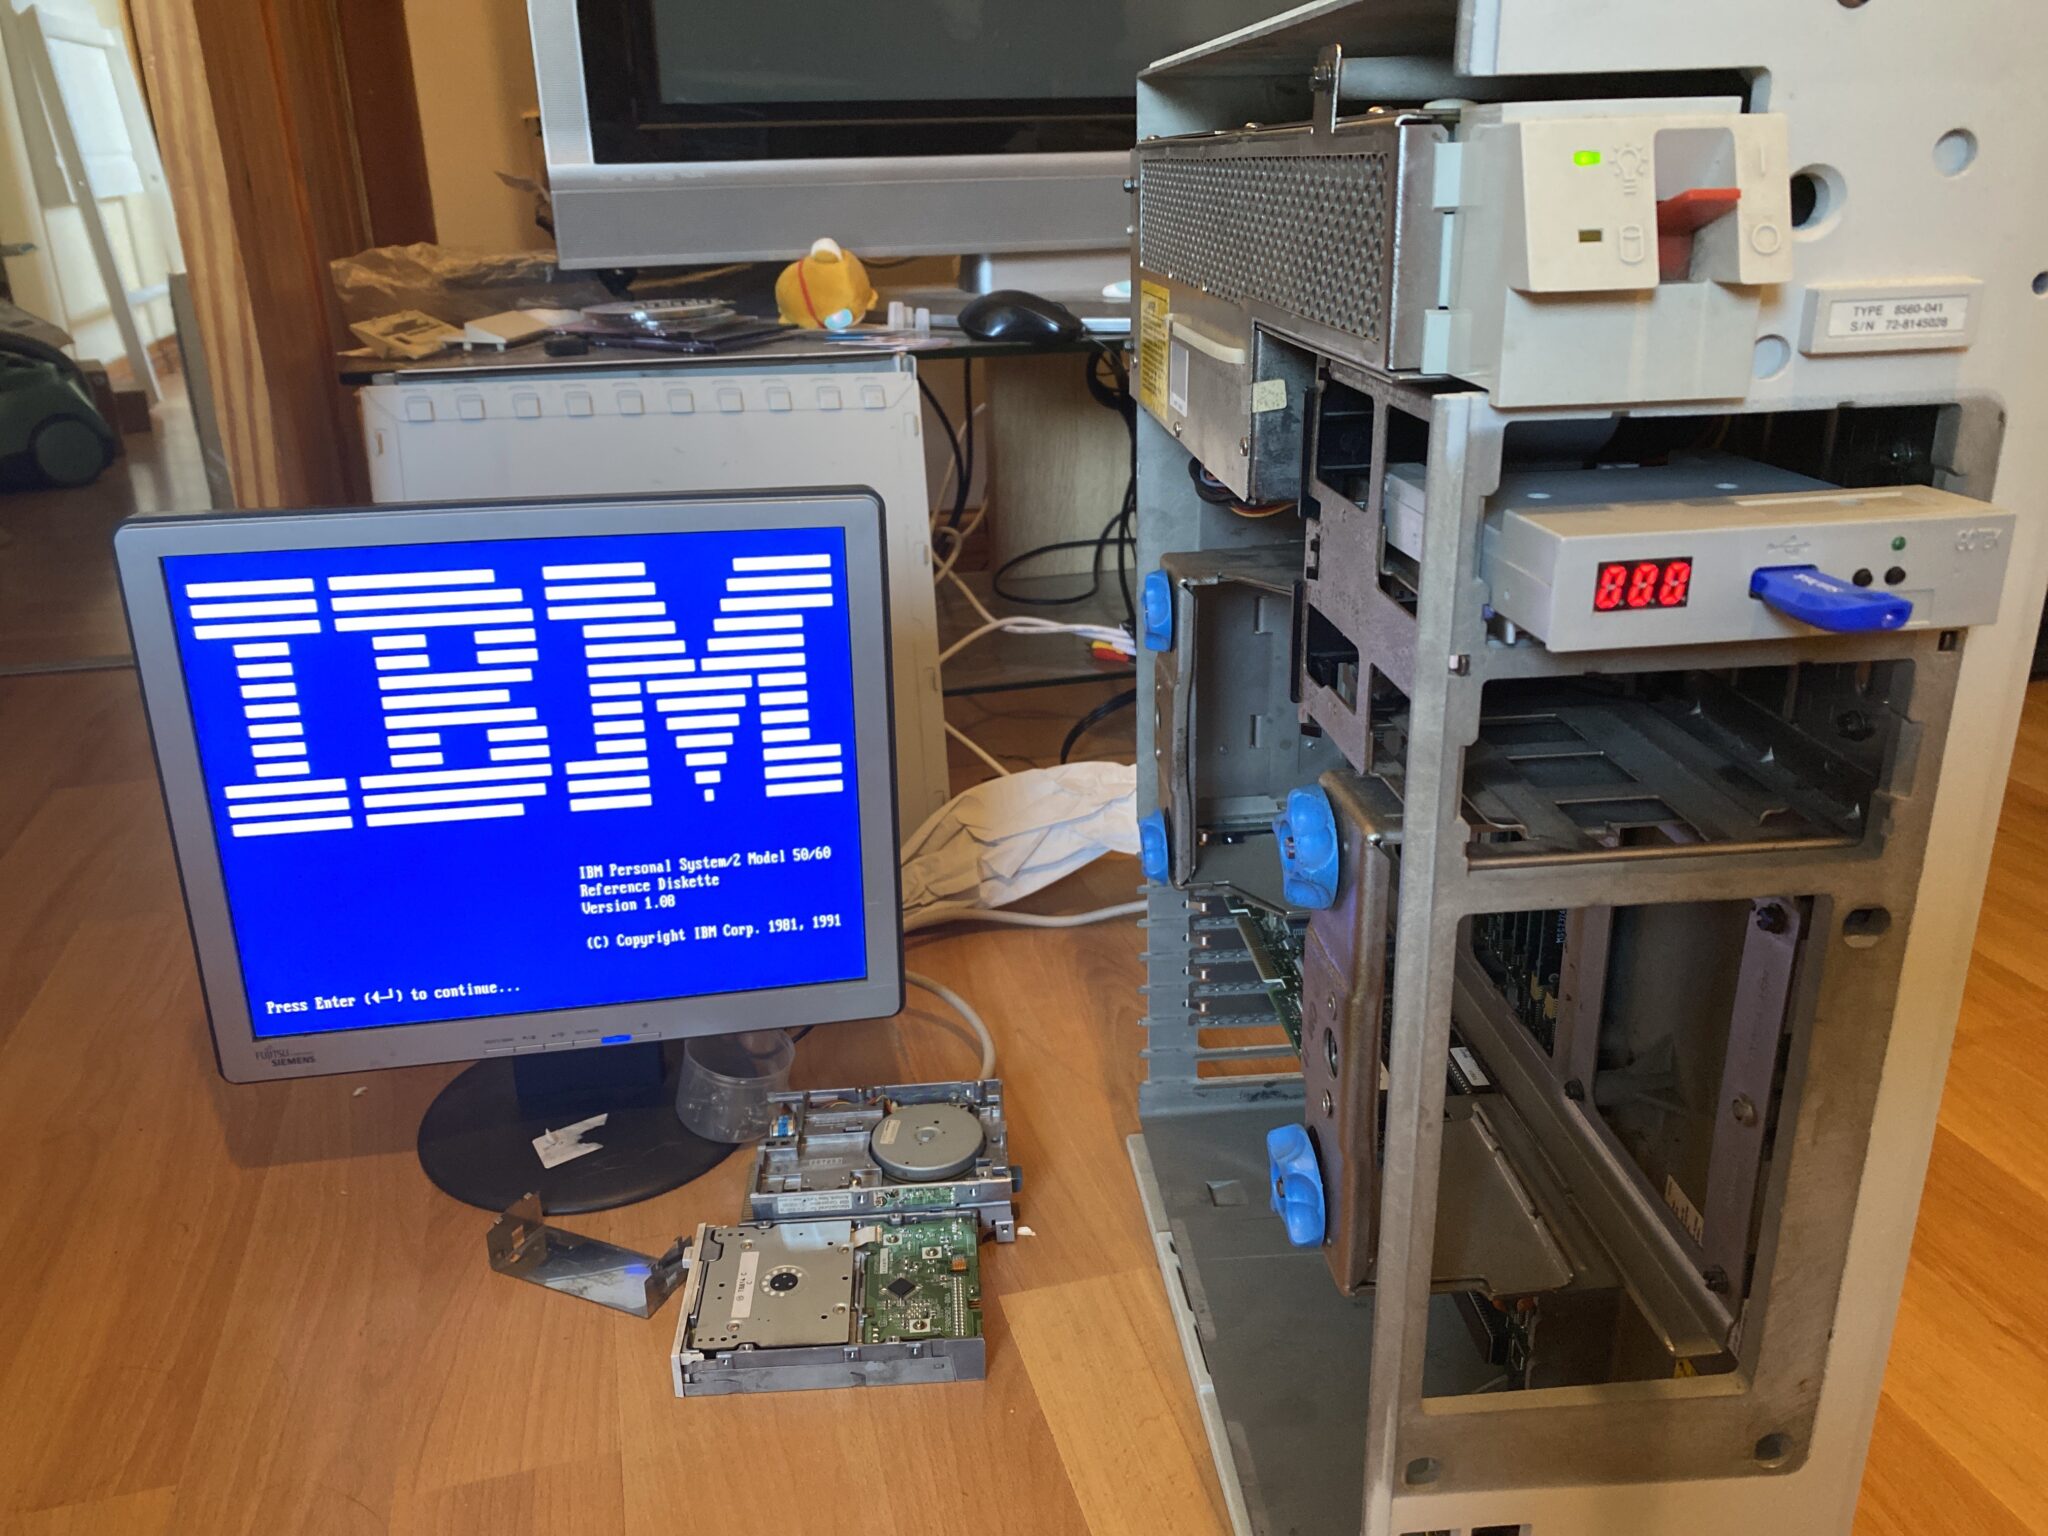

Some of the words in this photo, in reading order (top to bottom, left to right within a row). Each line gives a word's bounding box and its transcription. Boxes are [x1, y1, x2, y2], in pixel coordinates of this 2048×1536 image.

[1853, 304, 1884, 317] TYPE
[1894, 302, 1944, 316] 8560-041
[1850, 320, 1875, 332] S/N
[186, 554, 843, 837] IBM
[579, 865, 603, 879] IBM
[609, 859, 671, 877] Personal
[679, 853, 741, 874] System/2
[748, 849, 786, 865] Model
[793, 846, 831, 861] 50/60
[580, 881, 650, 897] Reference
[658, 874, 720, 890] Diskette
[581, 899, 637, 914] Version
[586, 935, 609, 950] (C)
[616, 929, 686, 949] Copyright
[694, 925, 717, 940] IBM
[723, 923, 760, 939] Corp.
[768, 917, 804, 933] 1981,
[812, 913, 841, 928] 1991
[266, 1000, 308, 1015] Press
[314, 995, 356, 1011] Enter
[411, 988, 427, 1001] to
[434, 983, 520, 999] continue...
[271, 1056, 315, 1067] SIEMENS
